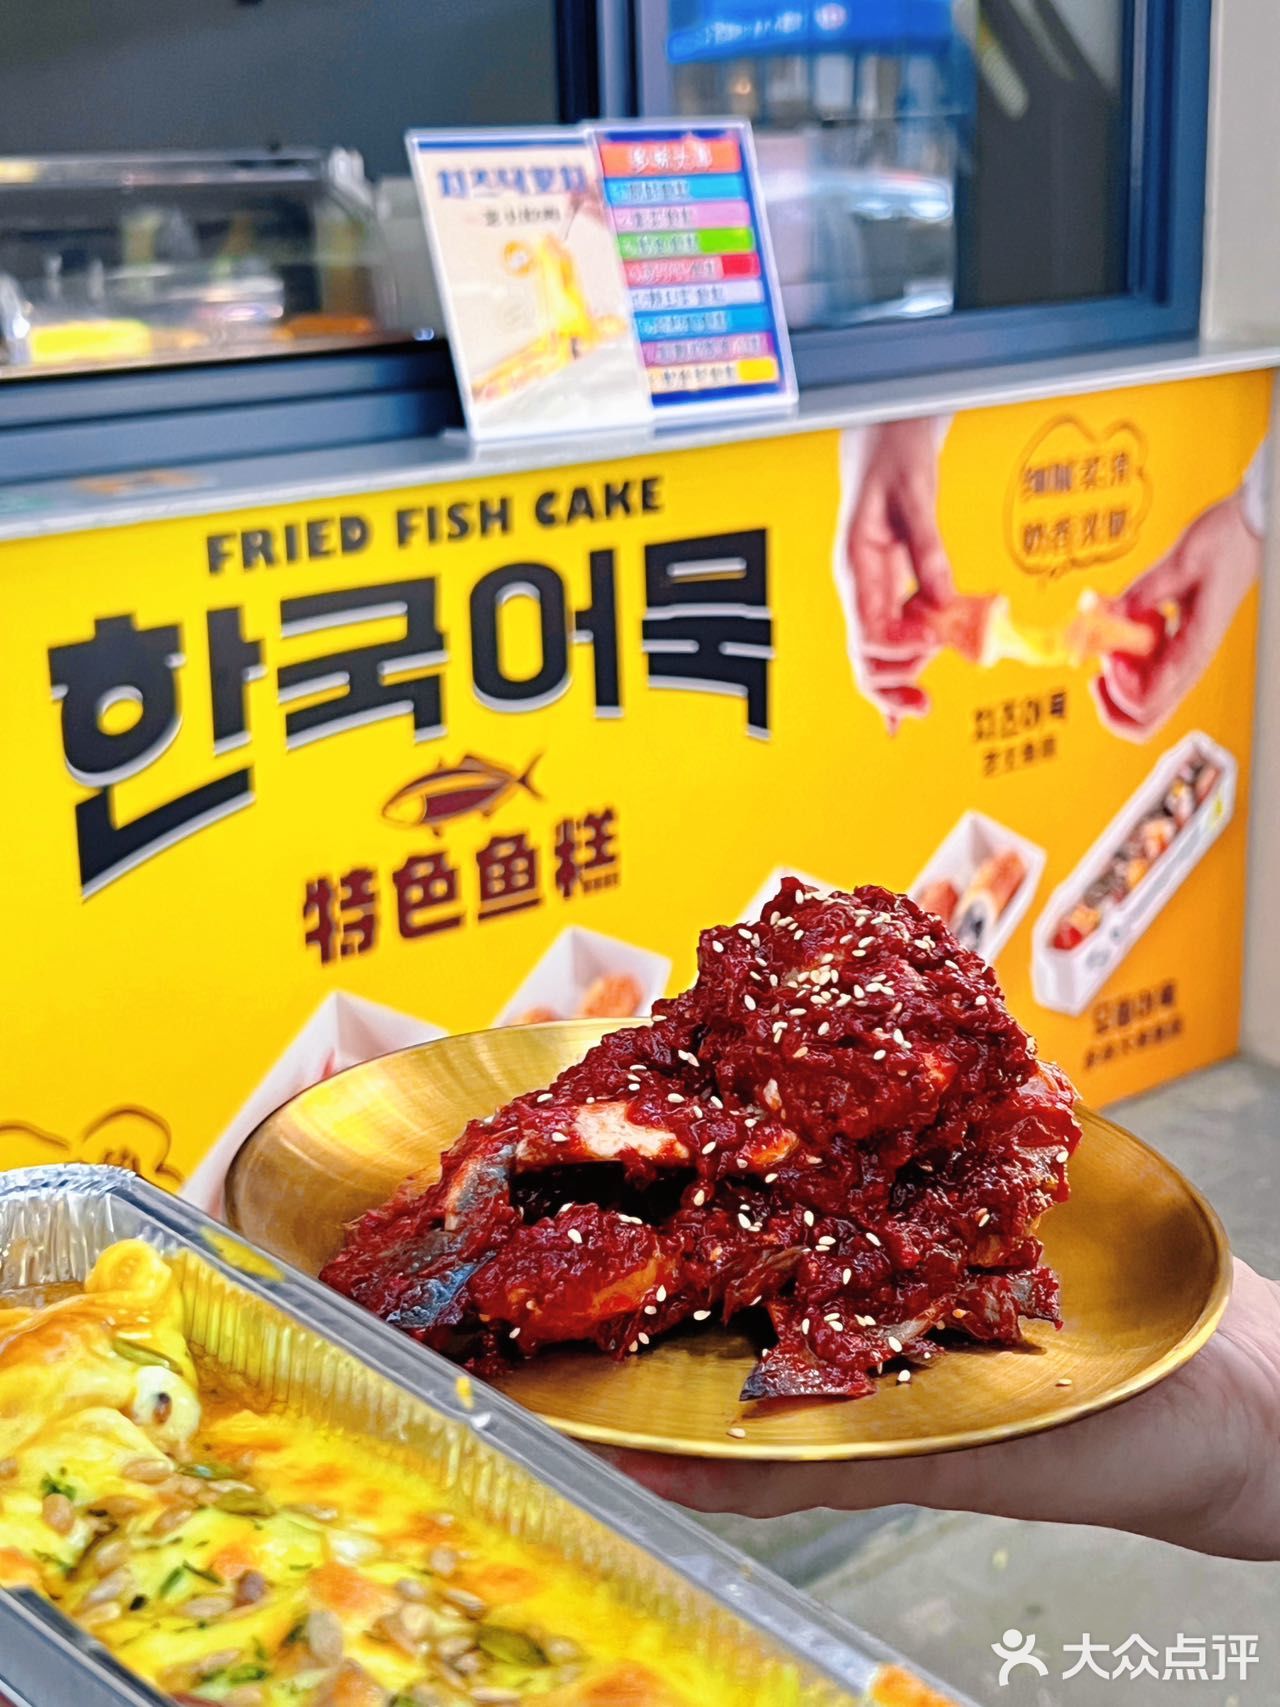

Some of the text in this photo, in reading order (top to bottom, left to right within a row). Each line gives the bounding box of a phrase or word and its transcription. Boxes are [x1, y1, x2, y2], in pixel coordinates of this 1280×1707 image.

[206, 476, 662, 576] FRIED FISH CAKE
[48, 528, 773, 902] 한국어묵
[303, 807, 619, 966] 特色鱼糕
